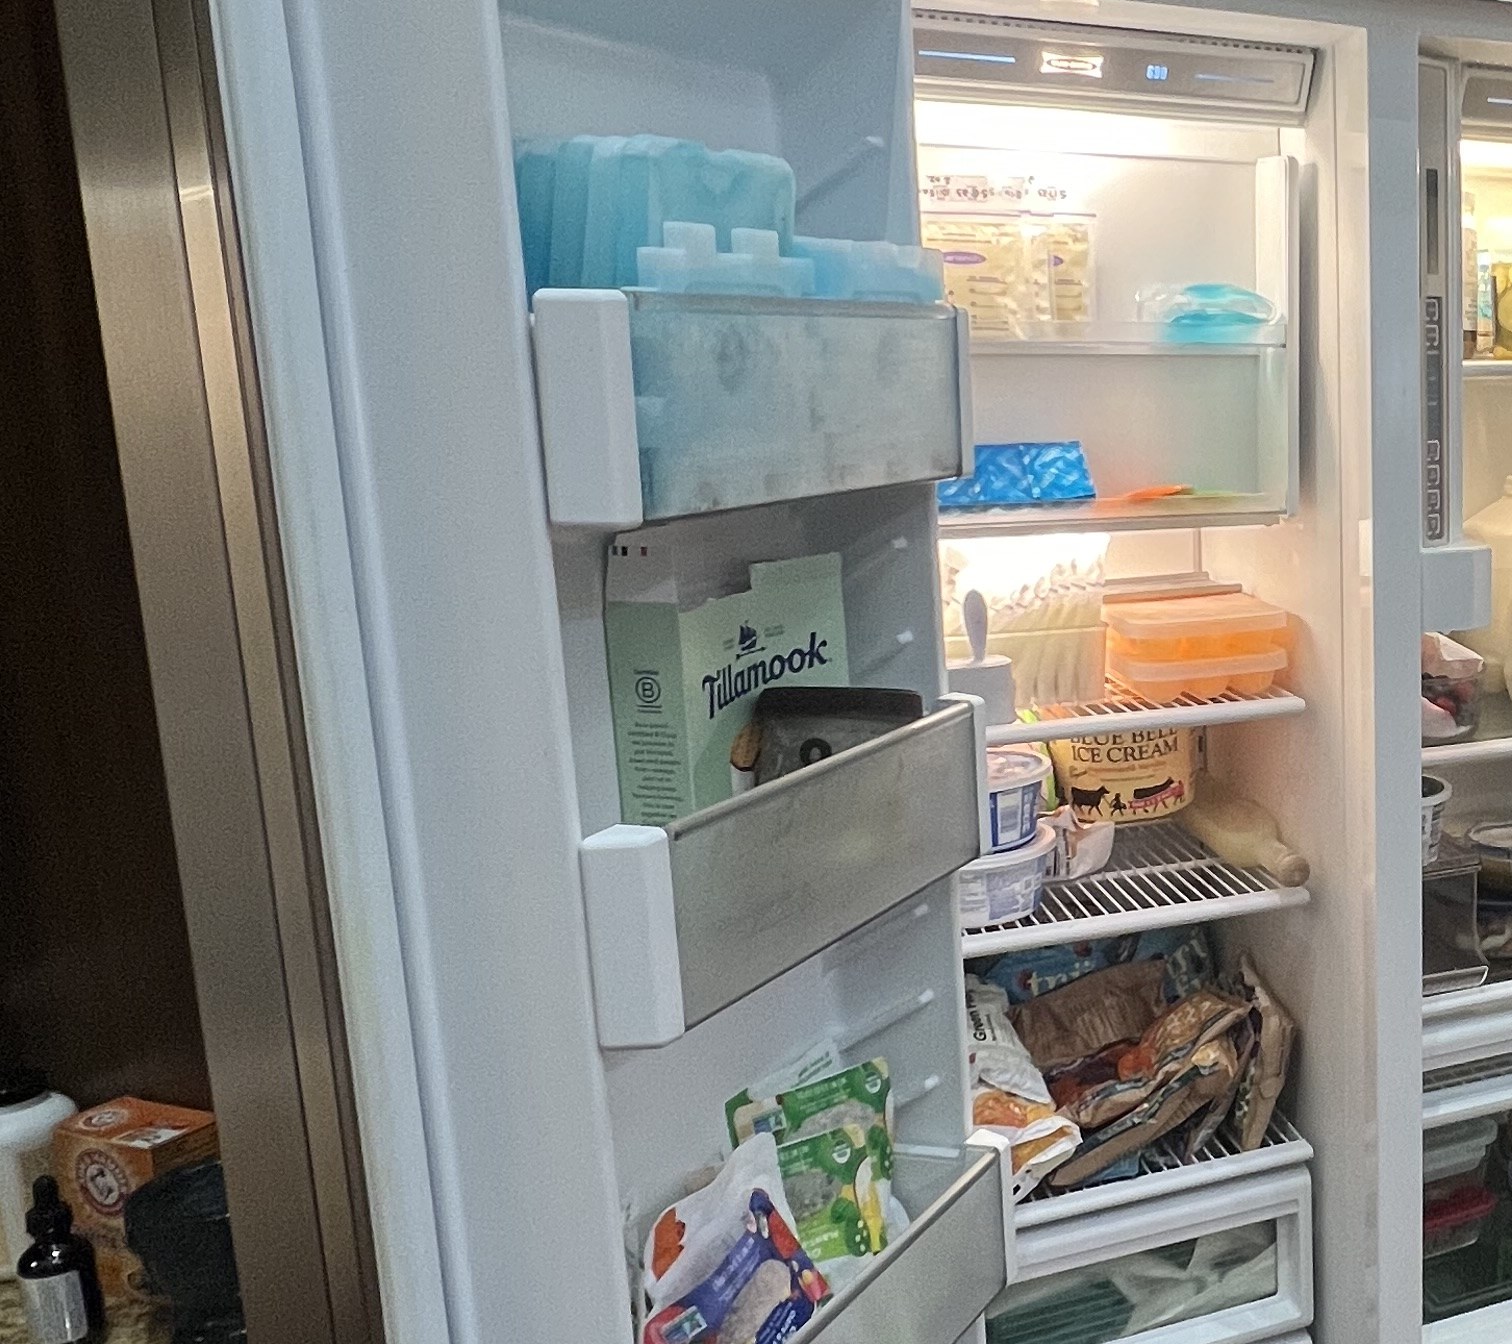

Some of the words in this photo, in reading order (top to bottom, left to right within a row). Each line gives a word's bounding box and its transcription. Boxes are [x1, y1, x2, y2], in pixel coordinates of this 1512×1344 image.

[702, 631, 828, 720] Tillamook
[1072, 745, 1103, 764] ICE
[1106, 737, 1178, 763] CREAM
[969, 1010, 988, 1042] Green
